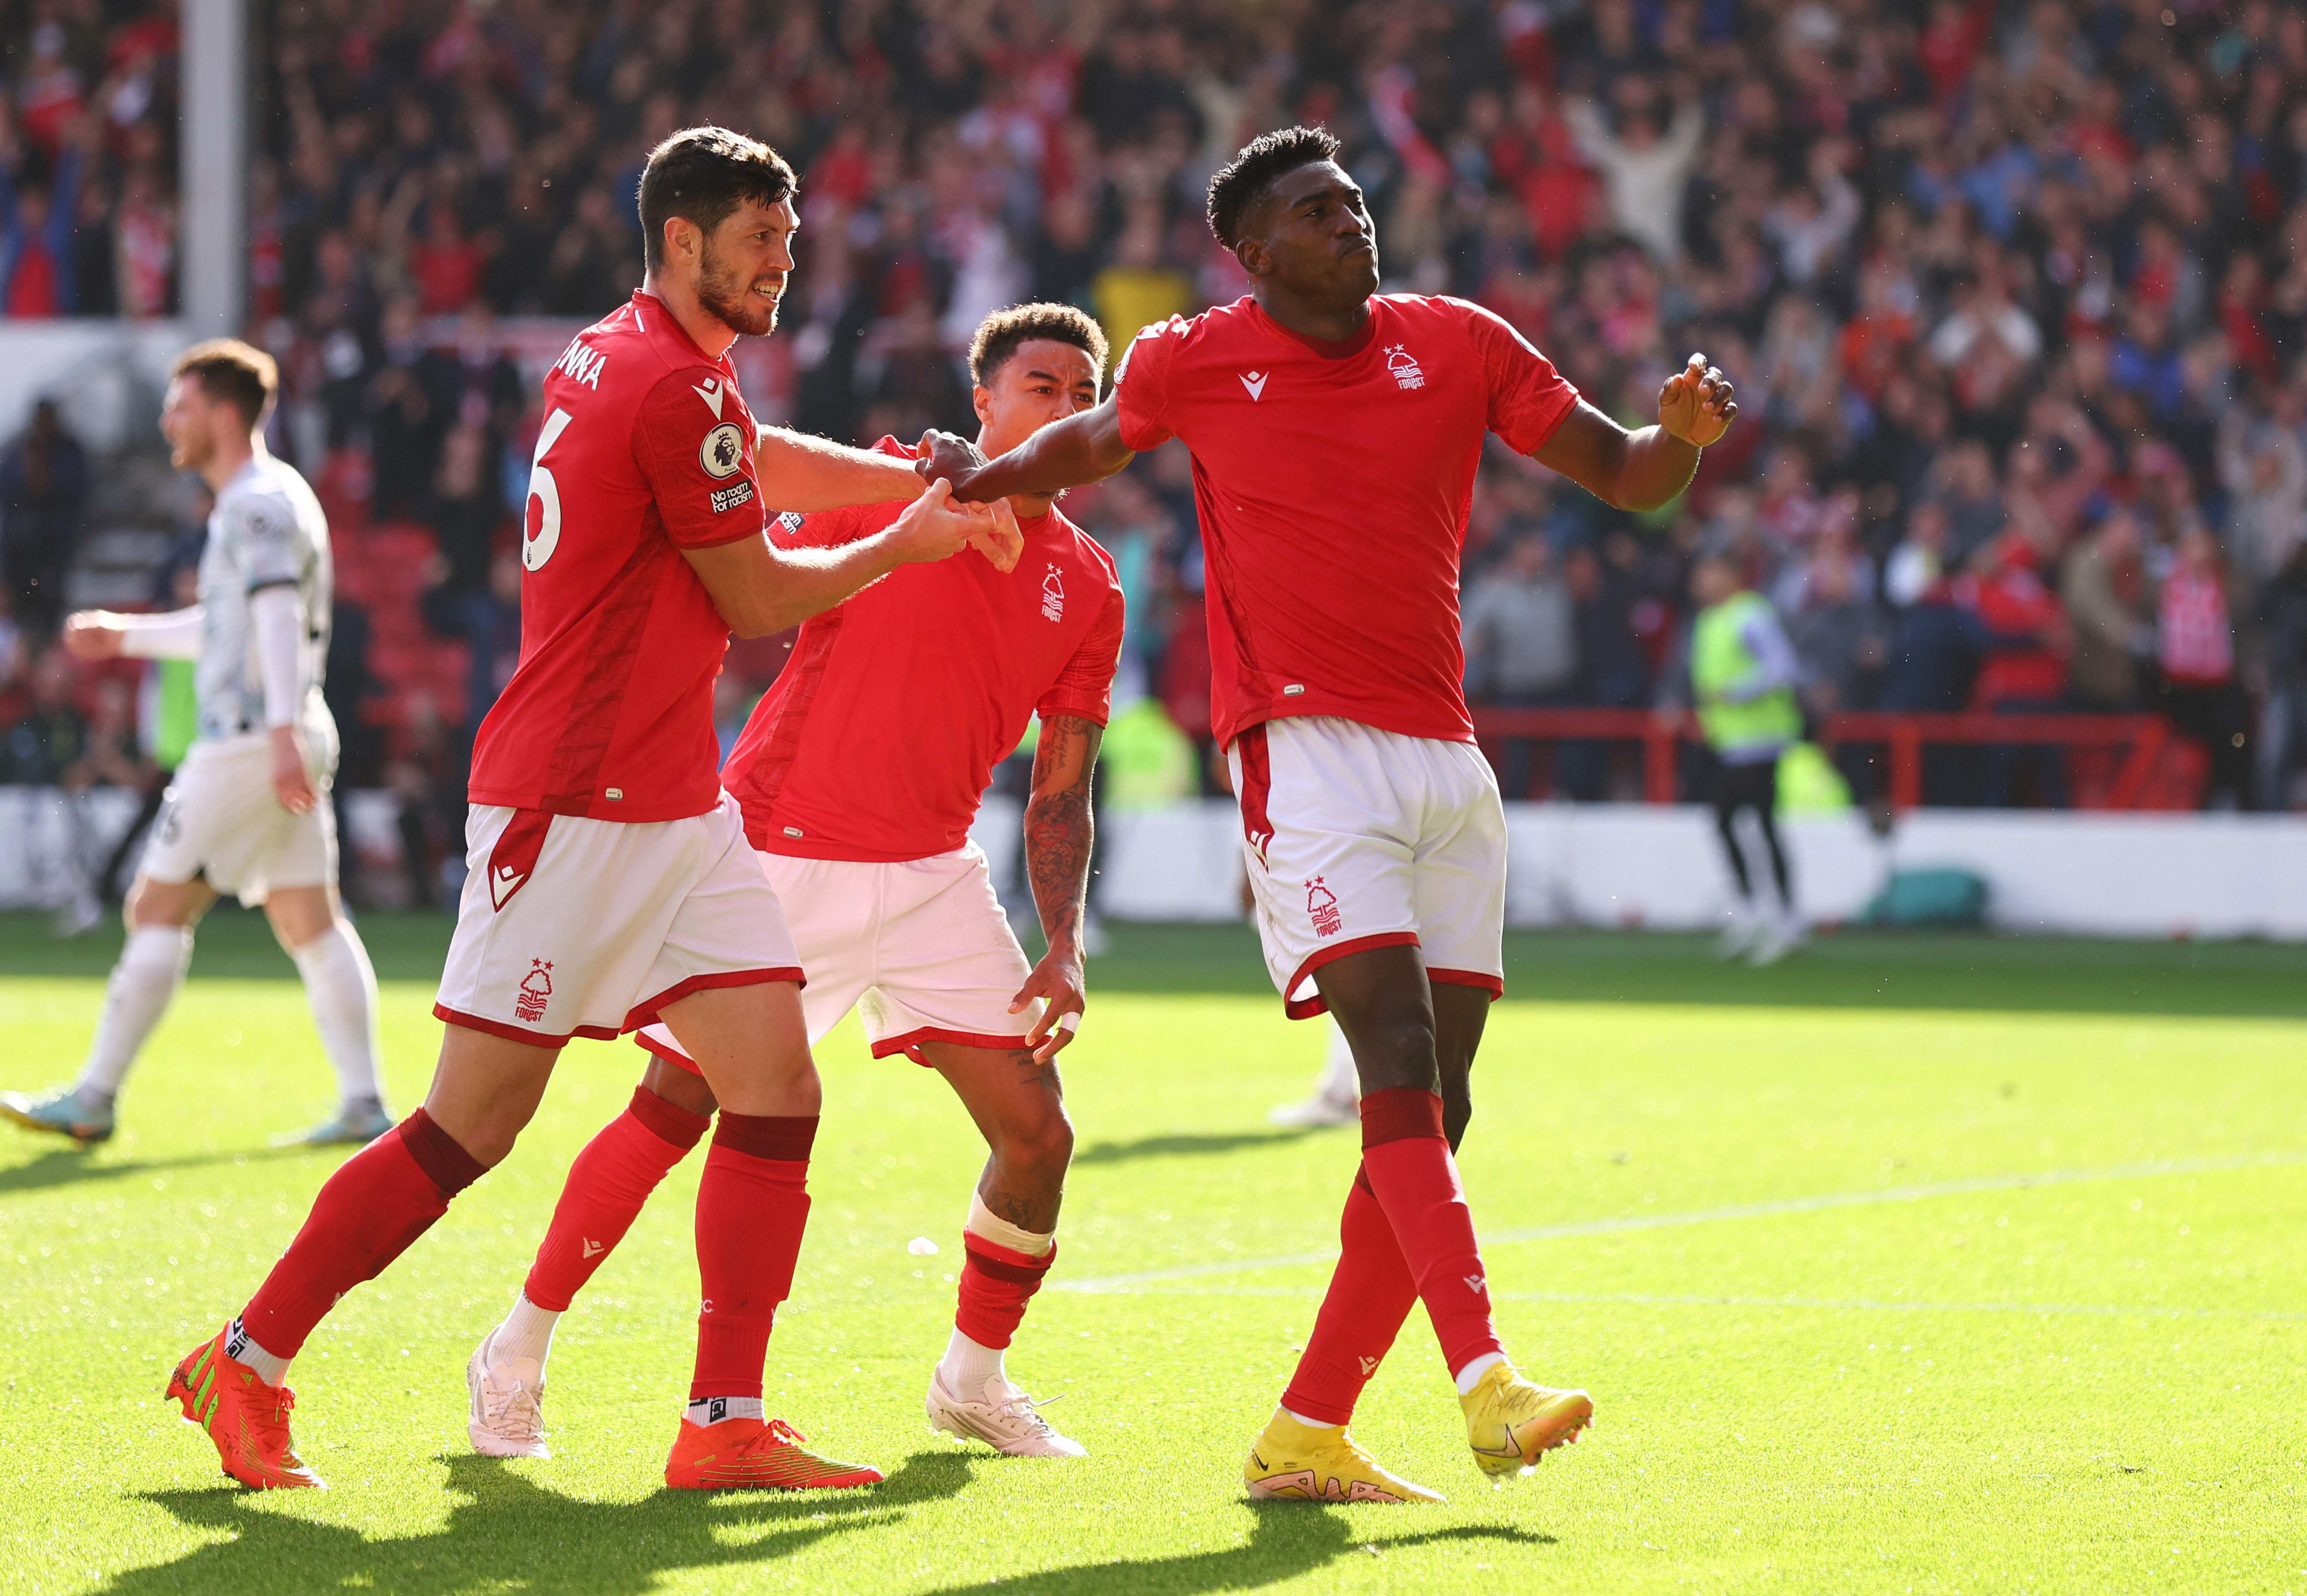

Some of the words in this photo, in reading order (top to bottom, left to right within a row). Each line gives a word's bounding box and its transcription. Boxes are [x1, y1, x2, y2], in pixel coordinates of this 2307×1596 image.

[522, 406, 574, 572] 6
[710, 491, 727, 504] No
[726, 482, 748, 498] room
[713, 501, 728, 513] for
[728, 490, 754, 508] racism
